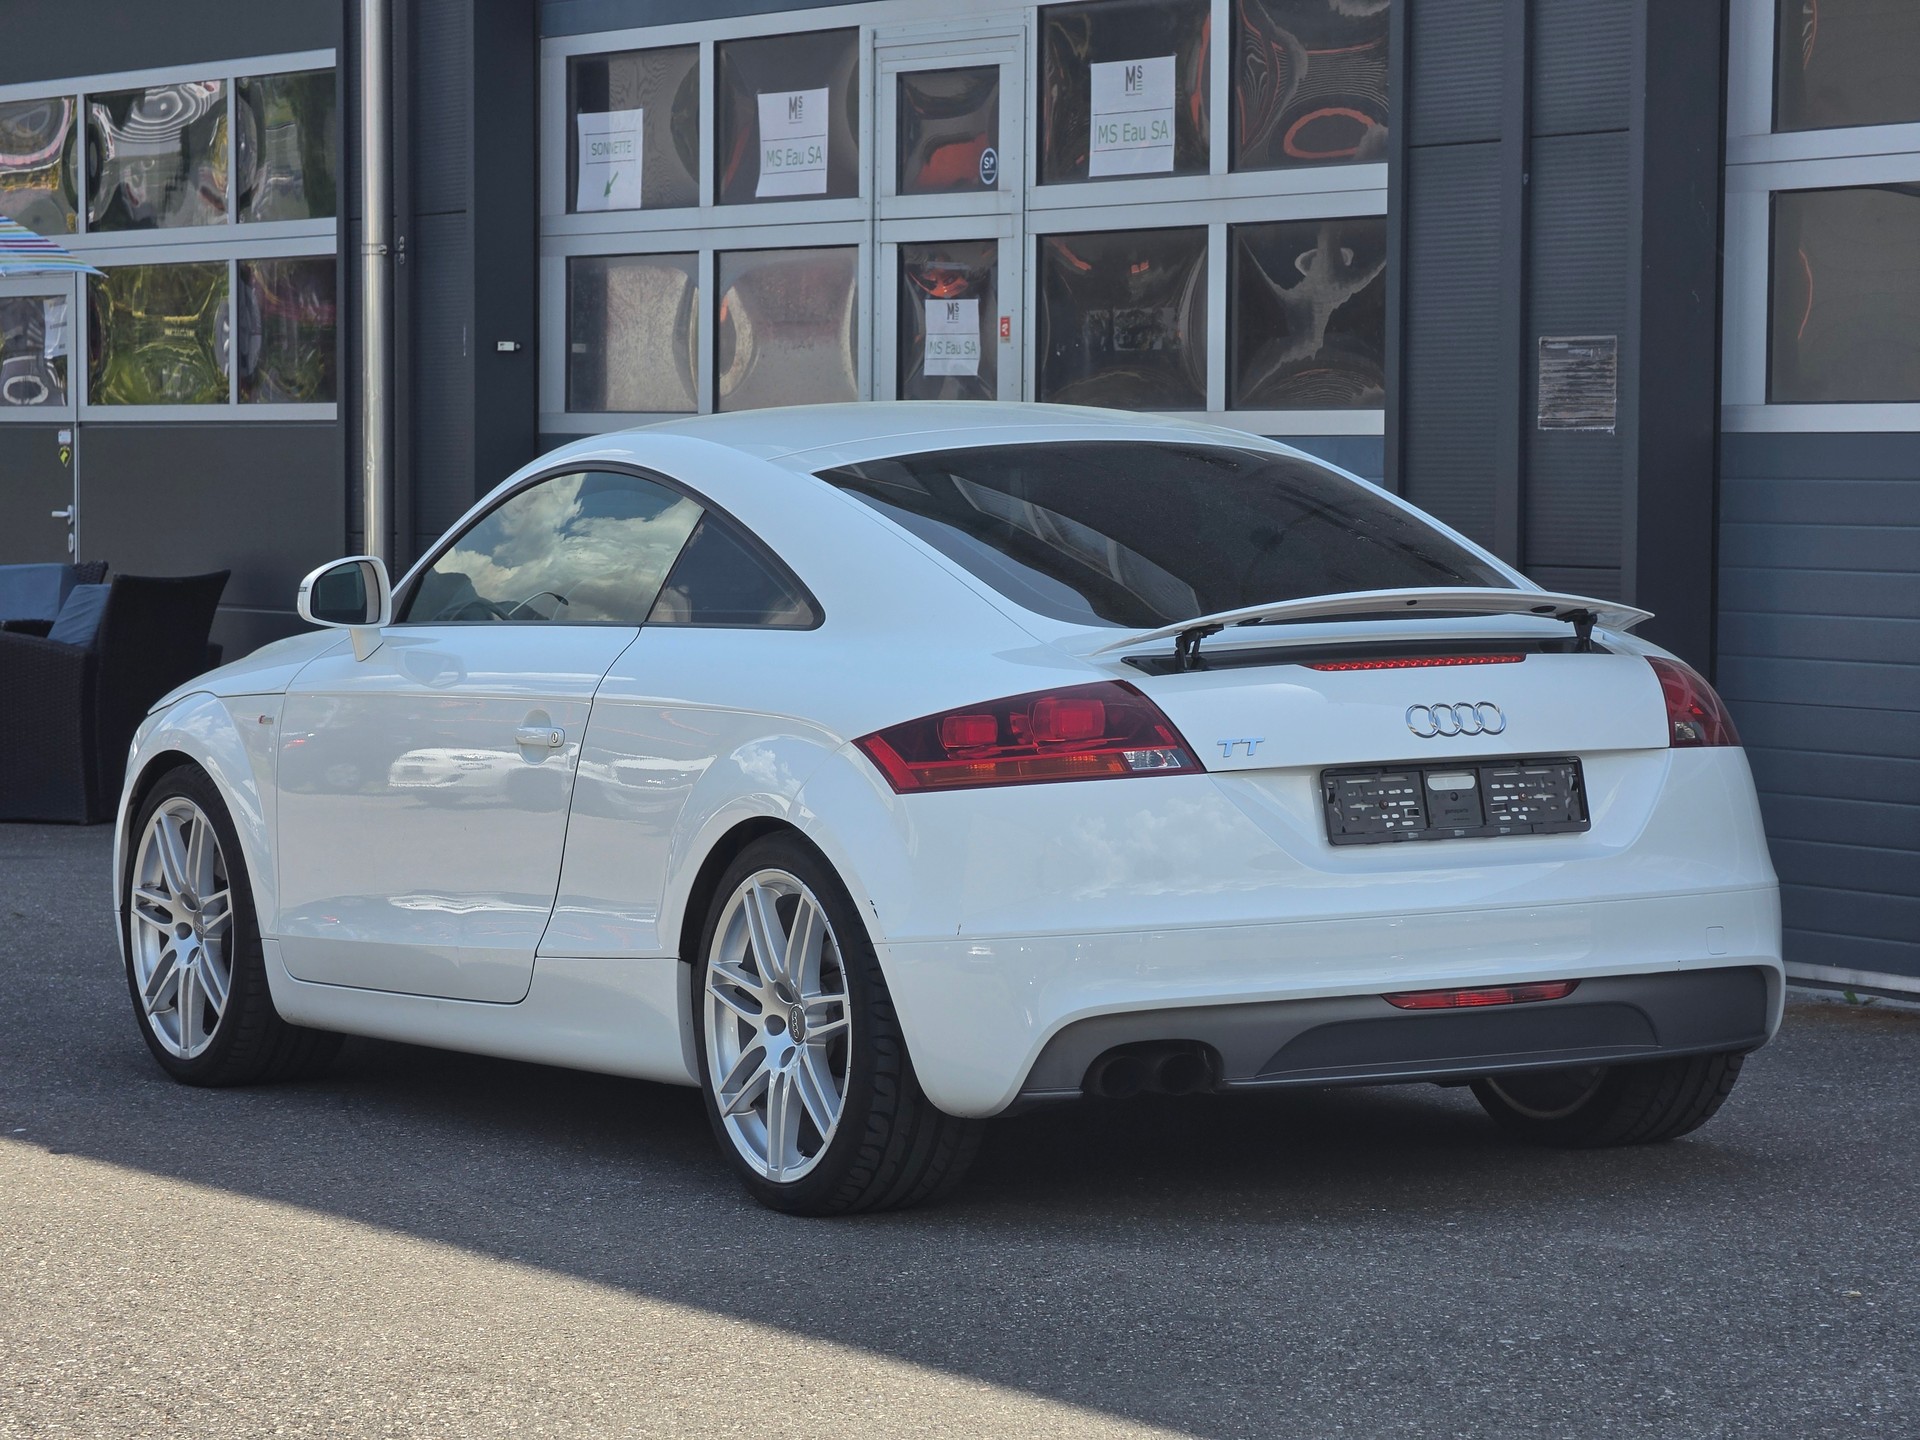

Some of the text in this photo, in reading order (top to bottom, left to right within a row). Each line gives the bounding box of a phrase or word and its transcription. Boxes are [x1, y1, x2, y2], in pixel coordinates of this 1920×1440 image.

[1097, 120, 1169, 145] MS Eau SA
[591, 140, 632, 156] SONNETTE
[766, 146, 823, 168] MS Eau SA
[929, 340, 977, 355] MS Eau SA
[1216, 737, 1265, 758] TT
